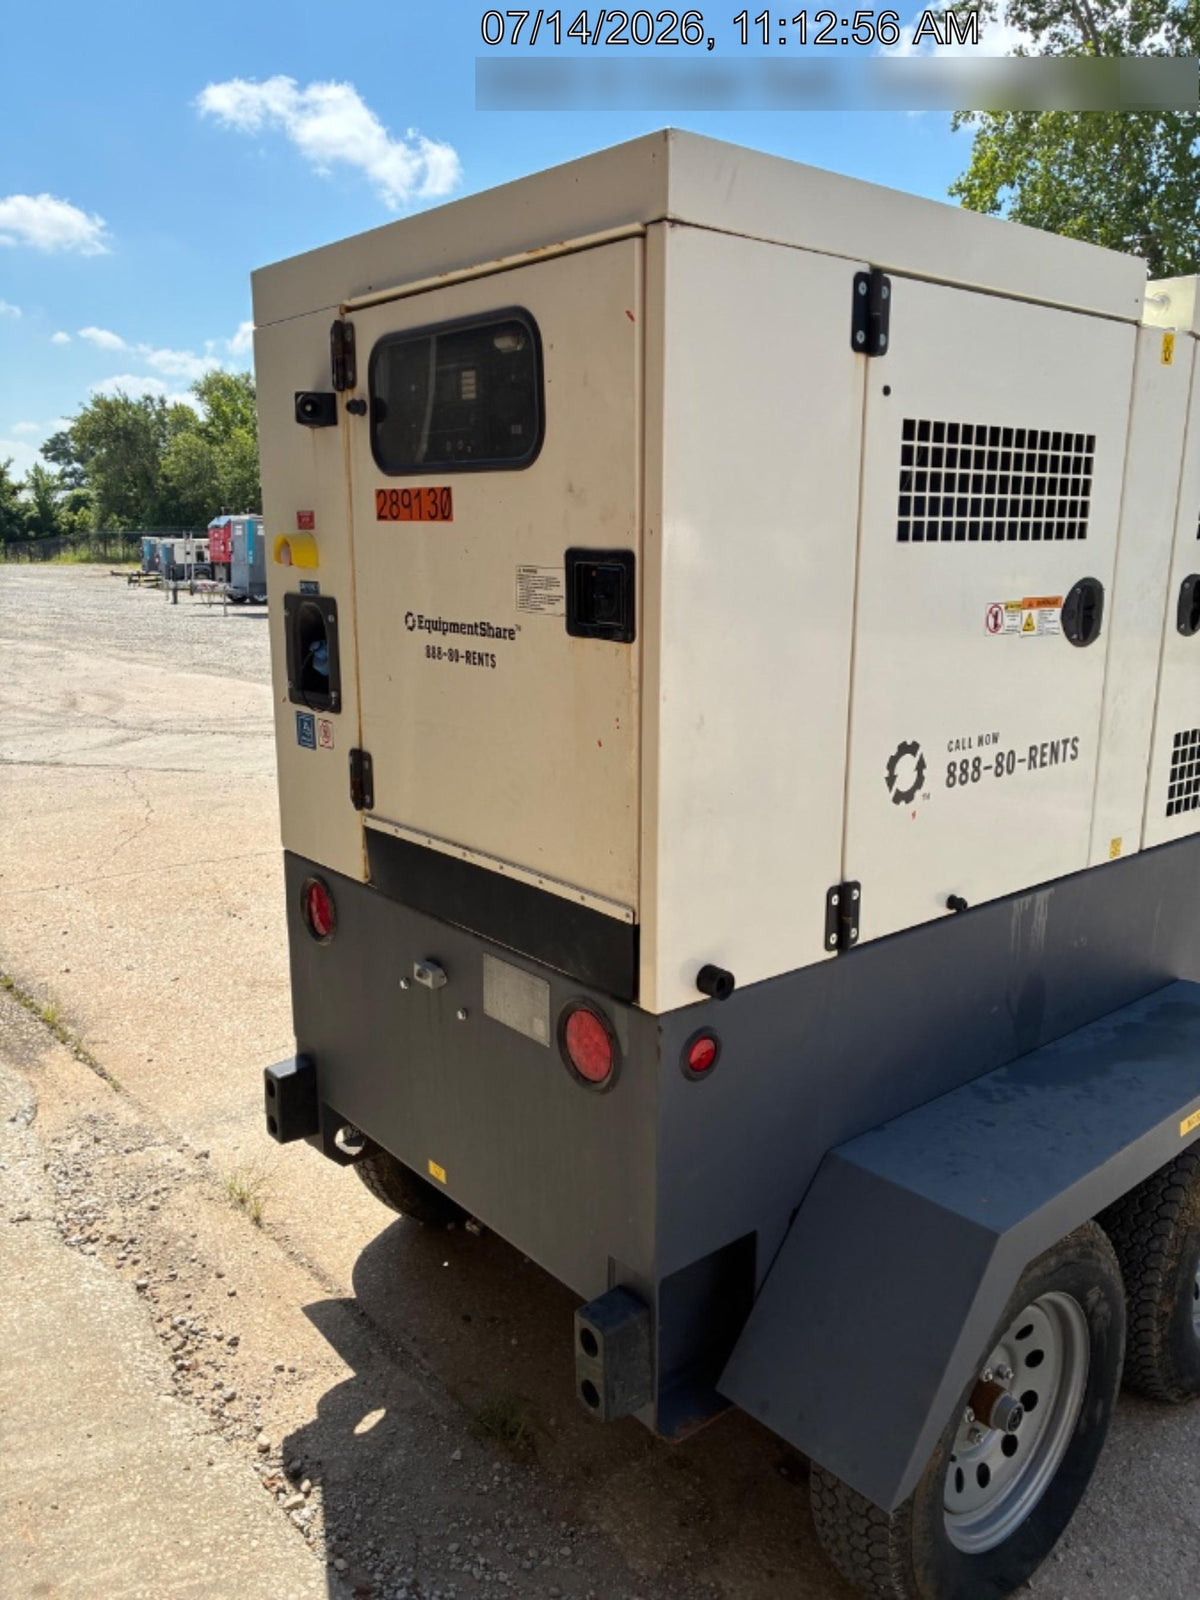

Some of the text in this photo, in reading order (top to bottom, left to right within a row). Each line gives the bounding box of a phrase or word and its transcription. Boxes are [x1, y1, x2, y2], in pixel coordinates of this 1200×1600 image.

[376, 487, 452, 520] 289130
[417, 614, 516, 641] EquipmentShare
[425, 644, 497, 669] 888-80-RENTS
[947, 731, 1000, 753] CALL NOW
[945, 736, 1080, 789] 888-80-RENTS
